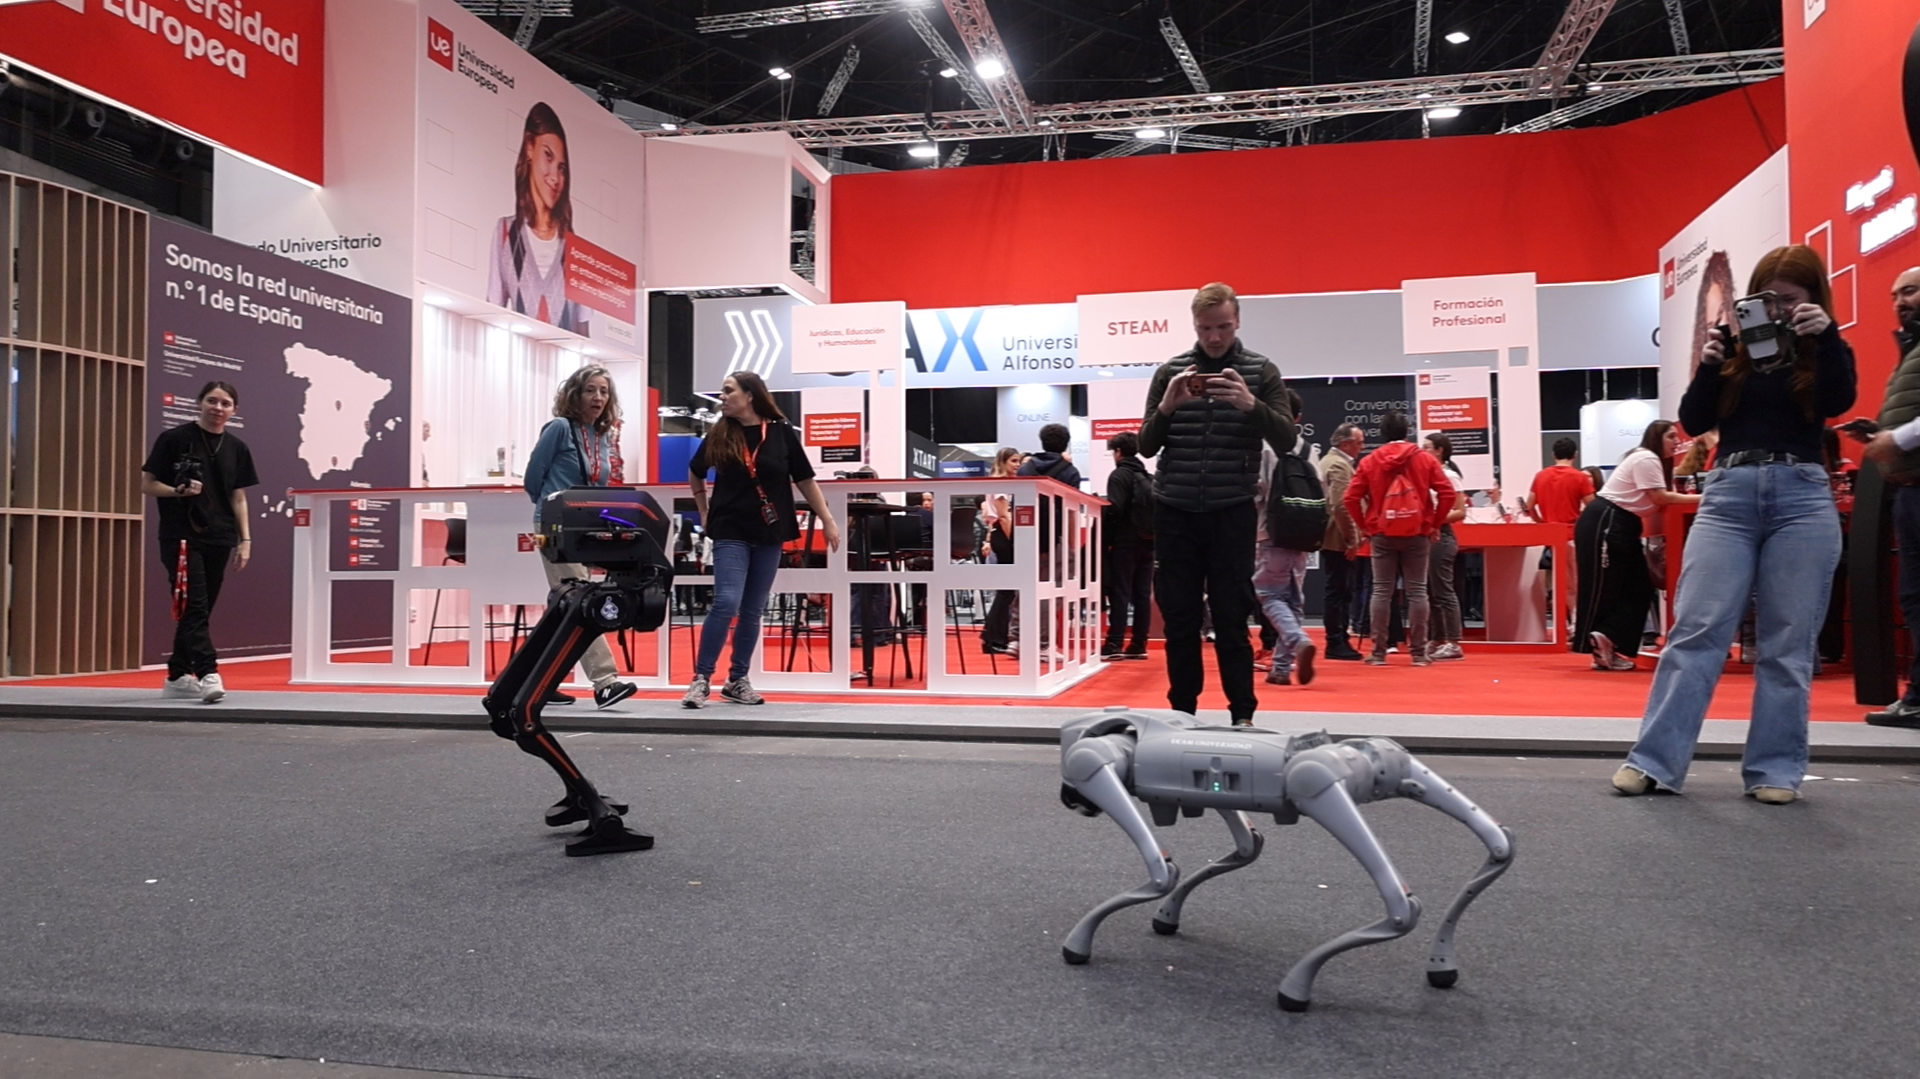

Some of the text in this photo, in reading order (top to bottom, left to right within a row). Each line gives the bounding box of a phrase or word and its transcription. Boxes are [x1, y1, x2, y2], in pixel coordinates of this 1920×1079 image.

[458, 42, 514, 90] Universidad
[458, 58, 498, 94] Europea
[280, 232, 382, 253] Universitario
[303, 254, 349, 269] recho
[165, 244, 384, 325] Somos la red universitaria
[197, 284, 206, 306] 1
[210, 288, 236, 312] de
[238, 294, 303, 330] España
[1434, 296, 1504, 310] Formación
[1107, 318, 1168, 336] STEAM
[1432, 312, 1506, 327] Profesional
[846, 327, 885, 336] Educación
[824, 338, 876, 346] Humanidades
[1002, 354, 1075, 370] Alfonso
[1344, 399, 1410, 411] Convenios
[1016, 412, 1050, 422] ONLINE
[1344, 414, 1368, 424] con
[912, 447, 936, 472] XTART
